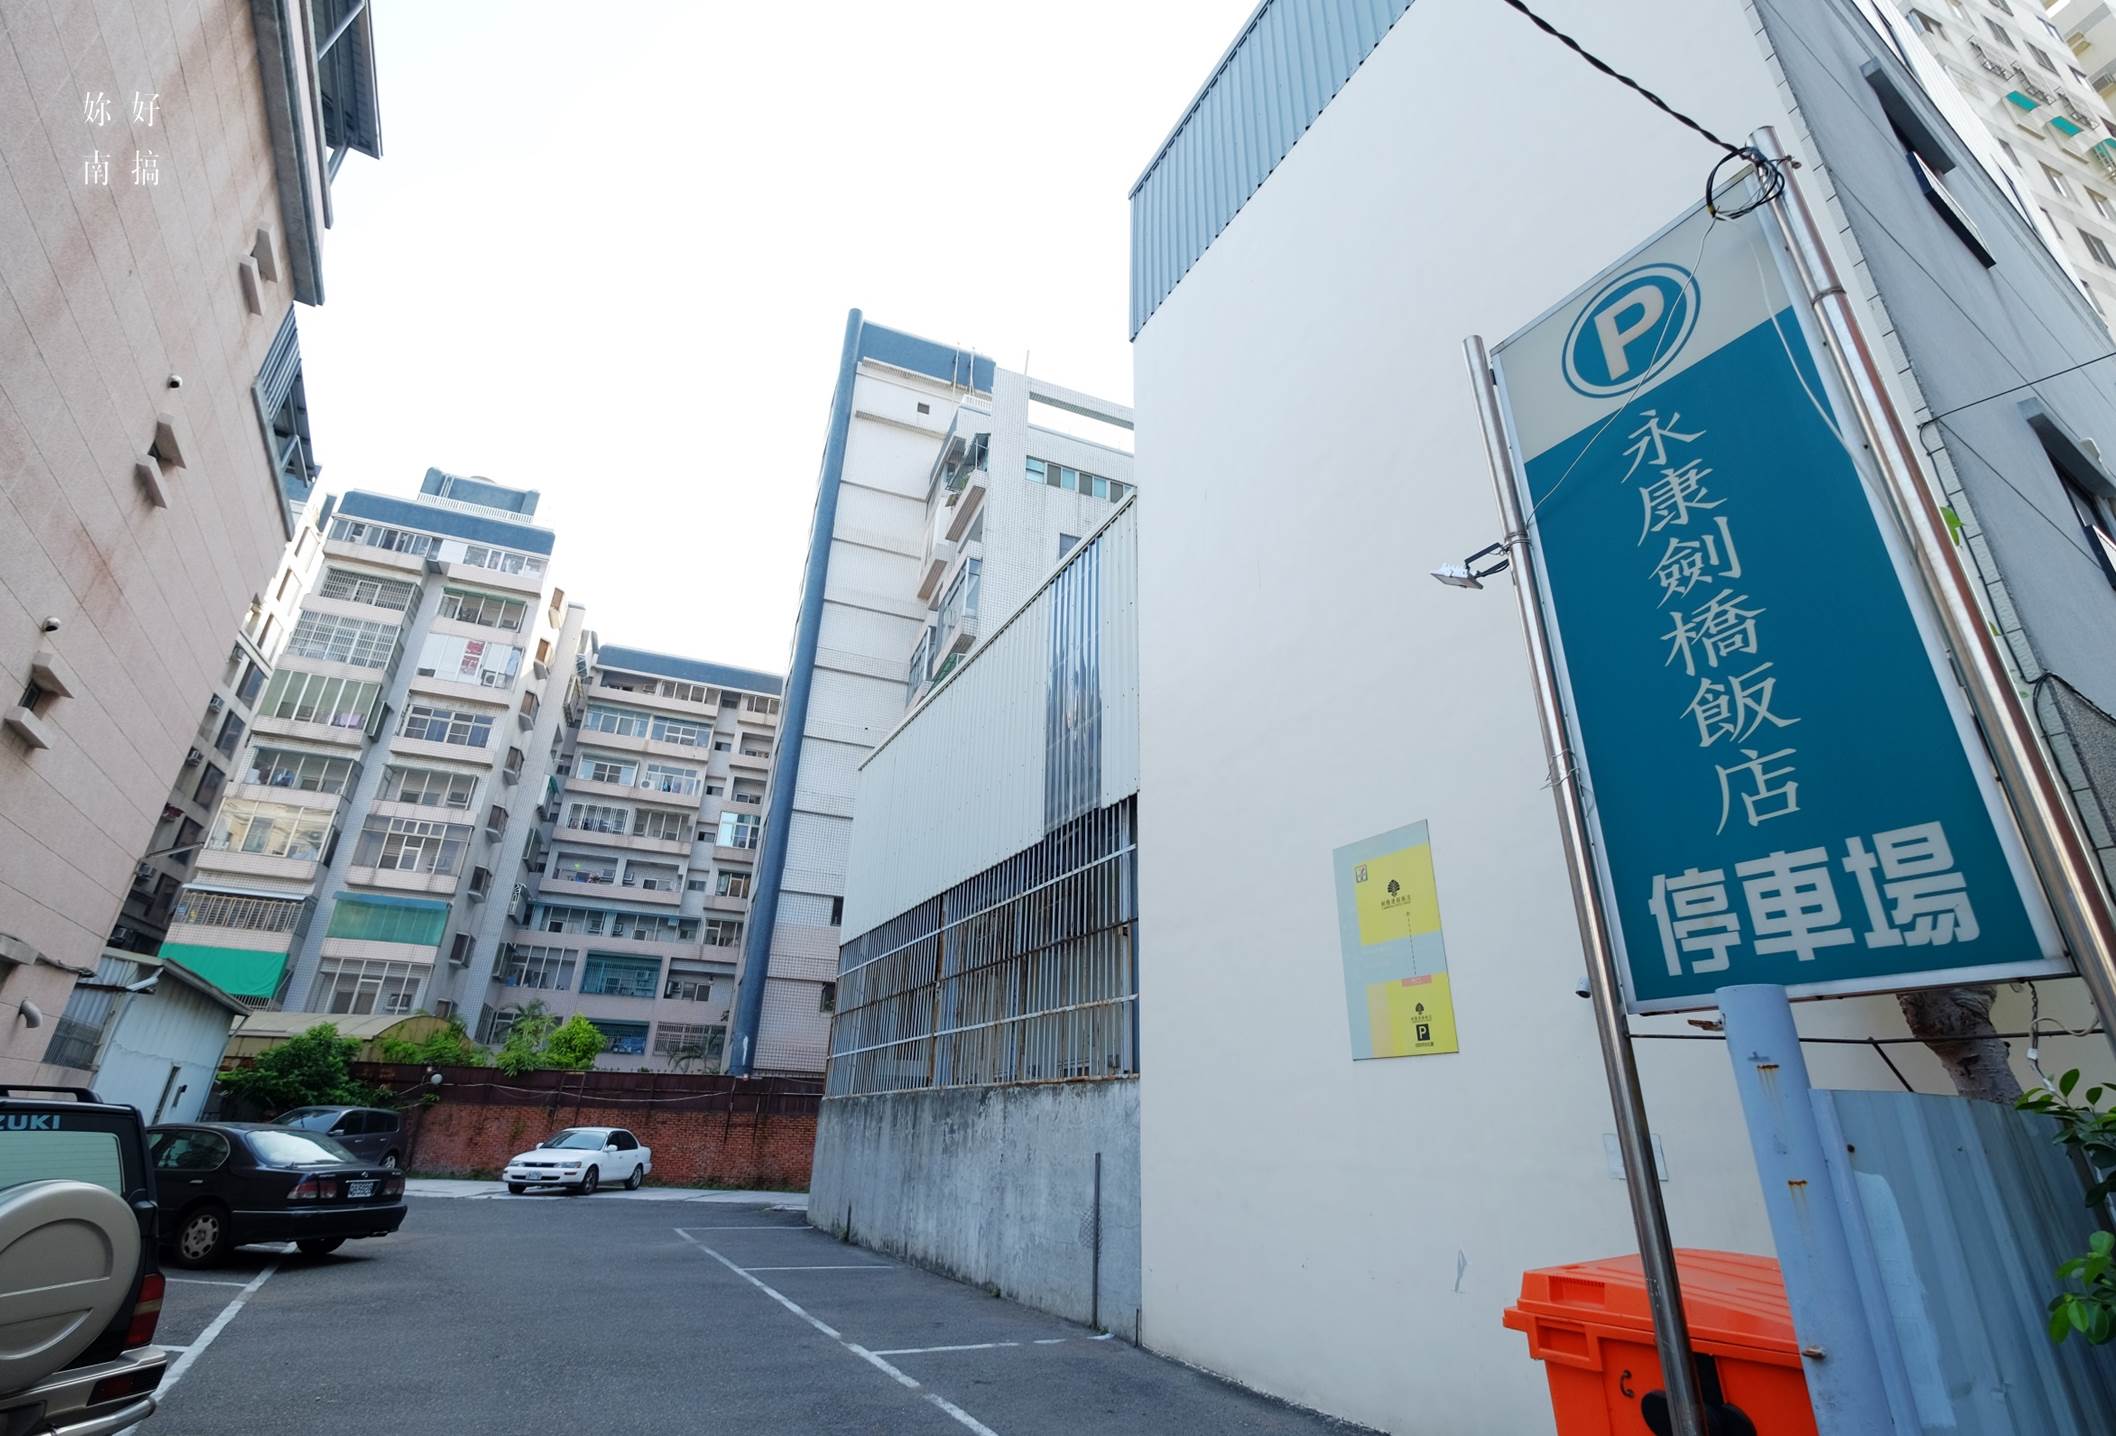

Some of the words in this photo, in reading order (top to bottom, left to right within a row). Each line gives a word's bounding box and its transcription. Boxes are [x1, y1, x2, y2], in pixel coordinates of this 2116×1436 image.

[1593, 284, 1665, 381] P
[1620, 408, 1802, 837] 永康劍橋飯店
[1648, 820, 1980, 977] 停車場
[1418, 1025, 1427, 1040] P
